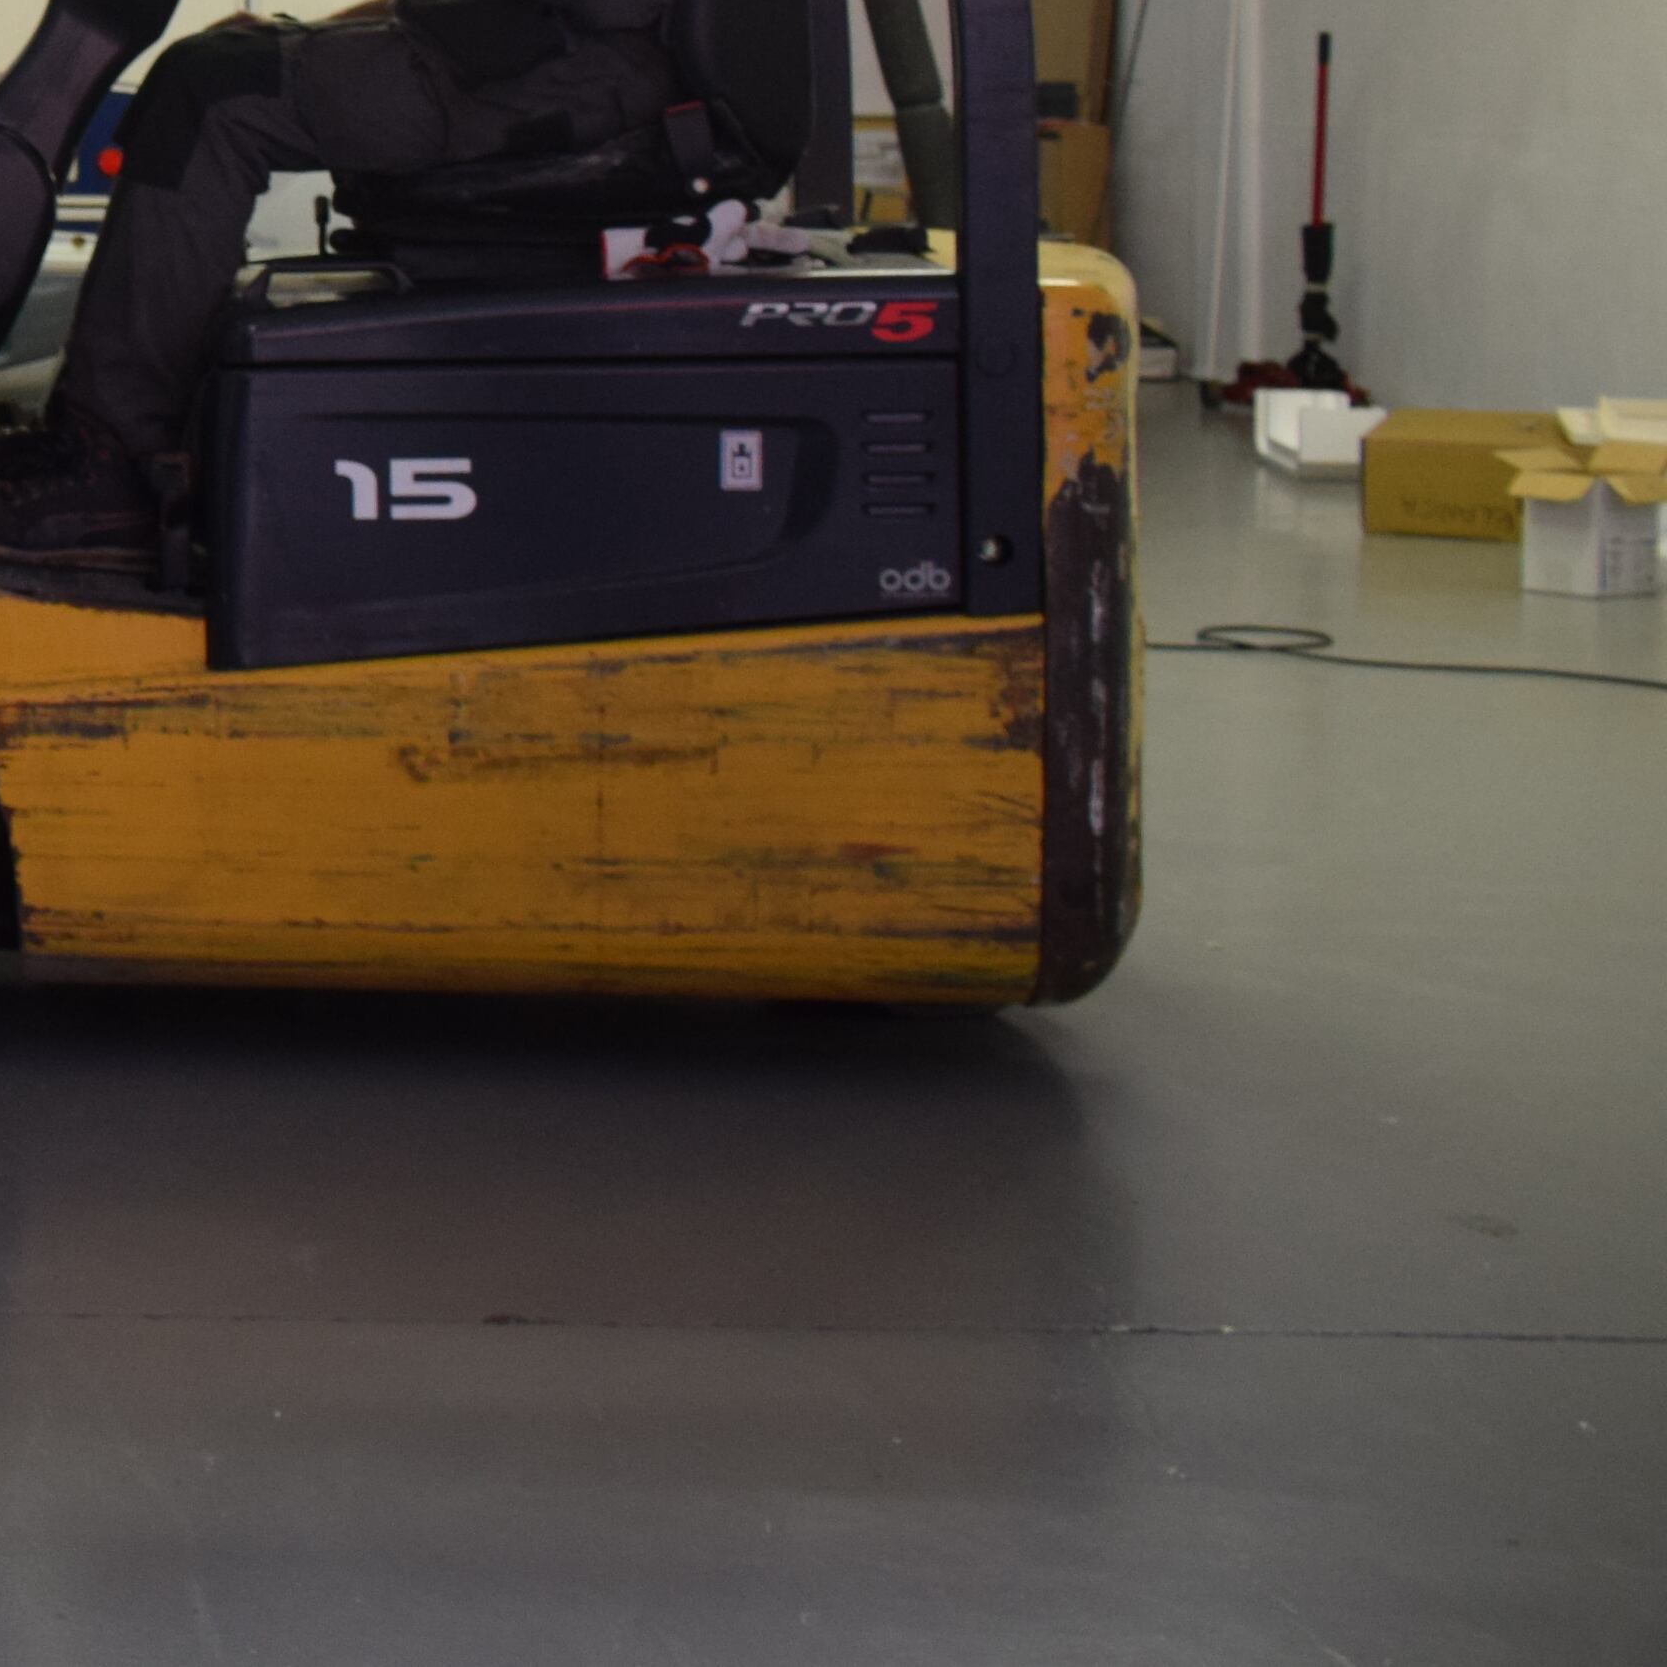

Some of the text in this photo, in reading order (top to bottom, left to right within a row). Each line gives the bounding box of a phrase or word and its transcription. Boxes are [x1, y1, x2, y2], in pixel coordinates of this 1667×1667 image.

[740, 300, 939, 344] PRO5
[333, 456, 478, 521] 15
[878, 561, 951, 592] odb
